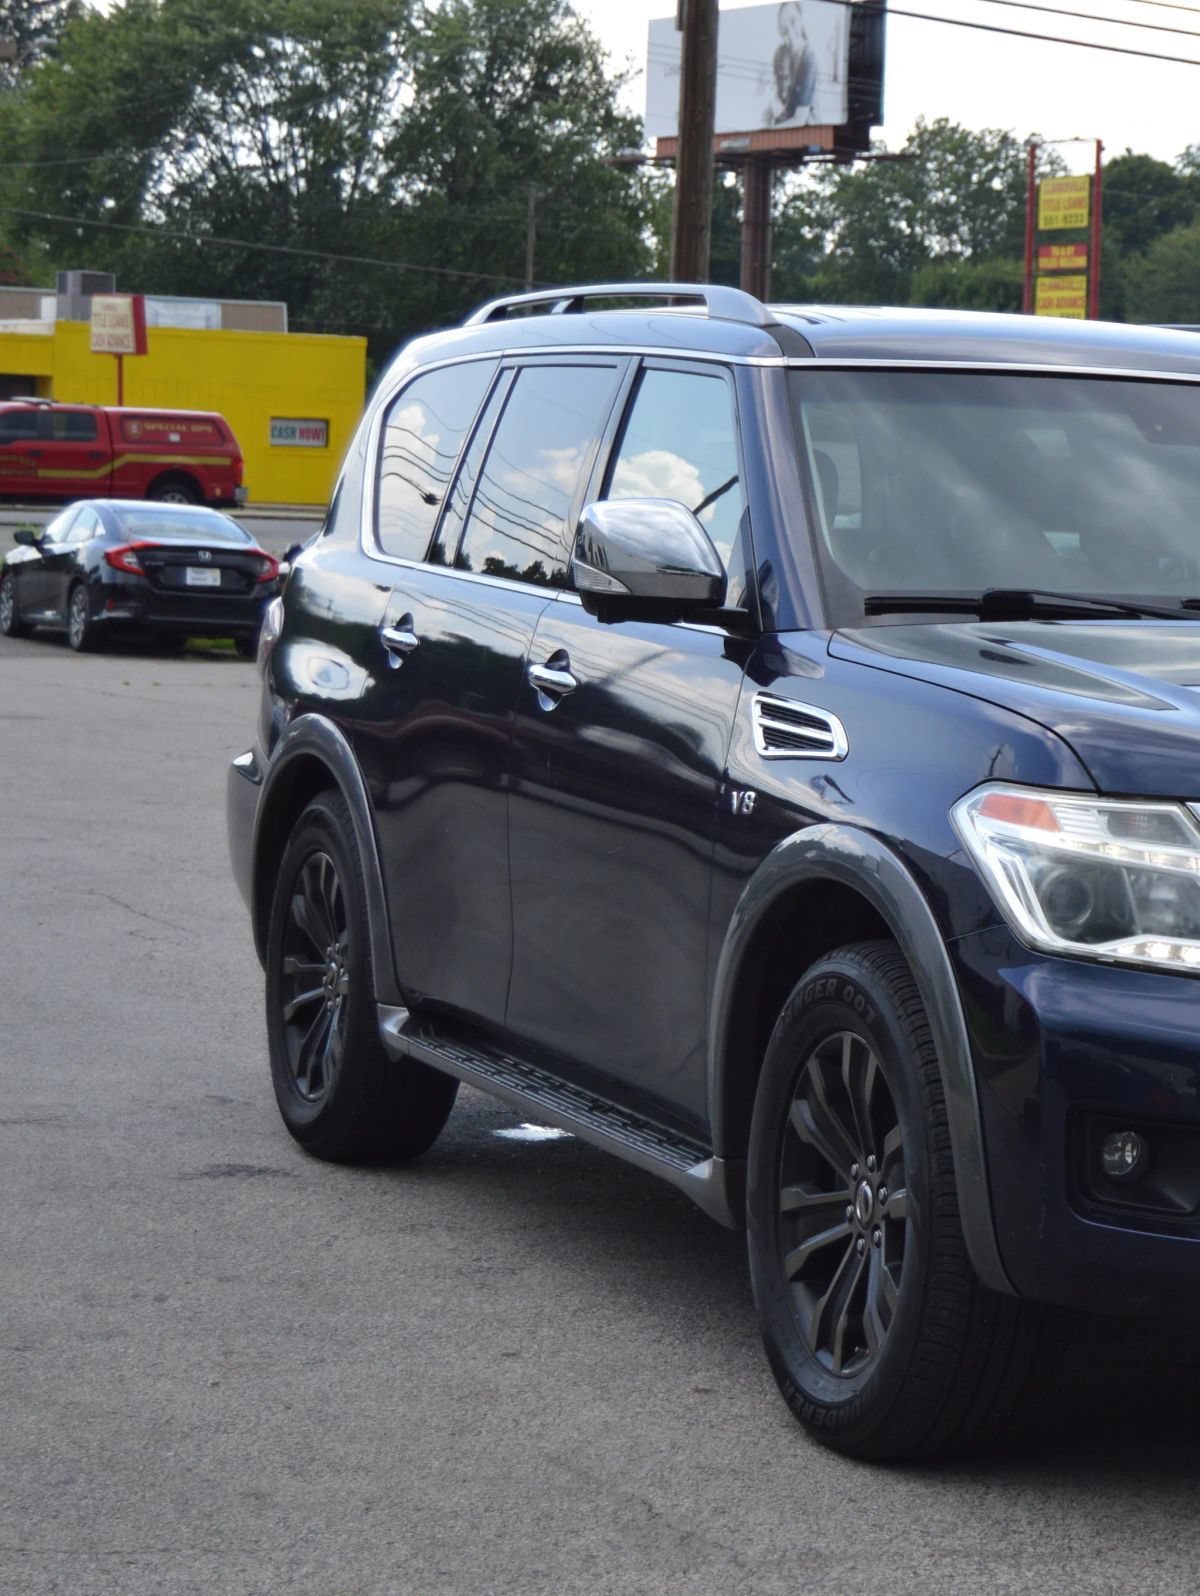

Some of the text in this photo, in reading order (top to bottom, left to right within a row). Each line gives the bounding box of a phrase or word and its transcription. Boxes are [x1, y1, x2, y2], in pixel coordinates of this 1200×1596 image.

[1043, 195, 1087, 212] TITLE LOANS
[143, 420, 213, 433] SPECIAL OPS
[271, 425, 325, 441] CASH NOW!
[732, 791, 756, 815] V8
